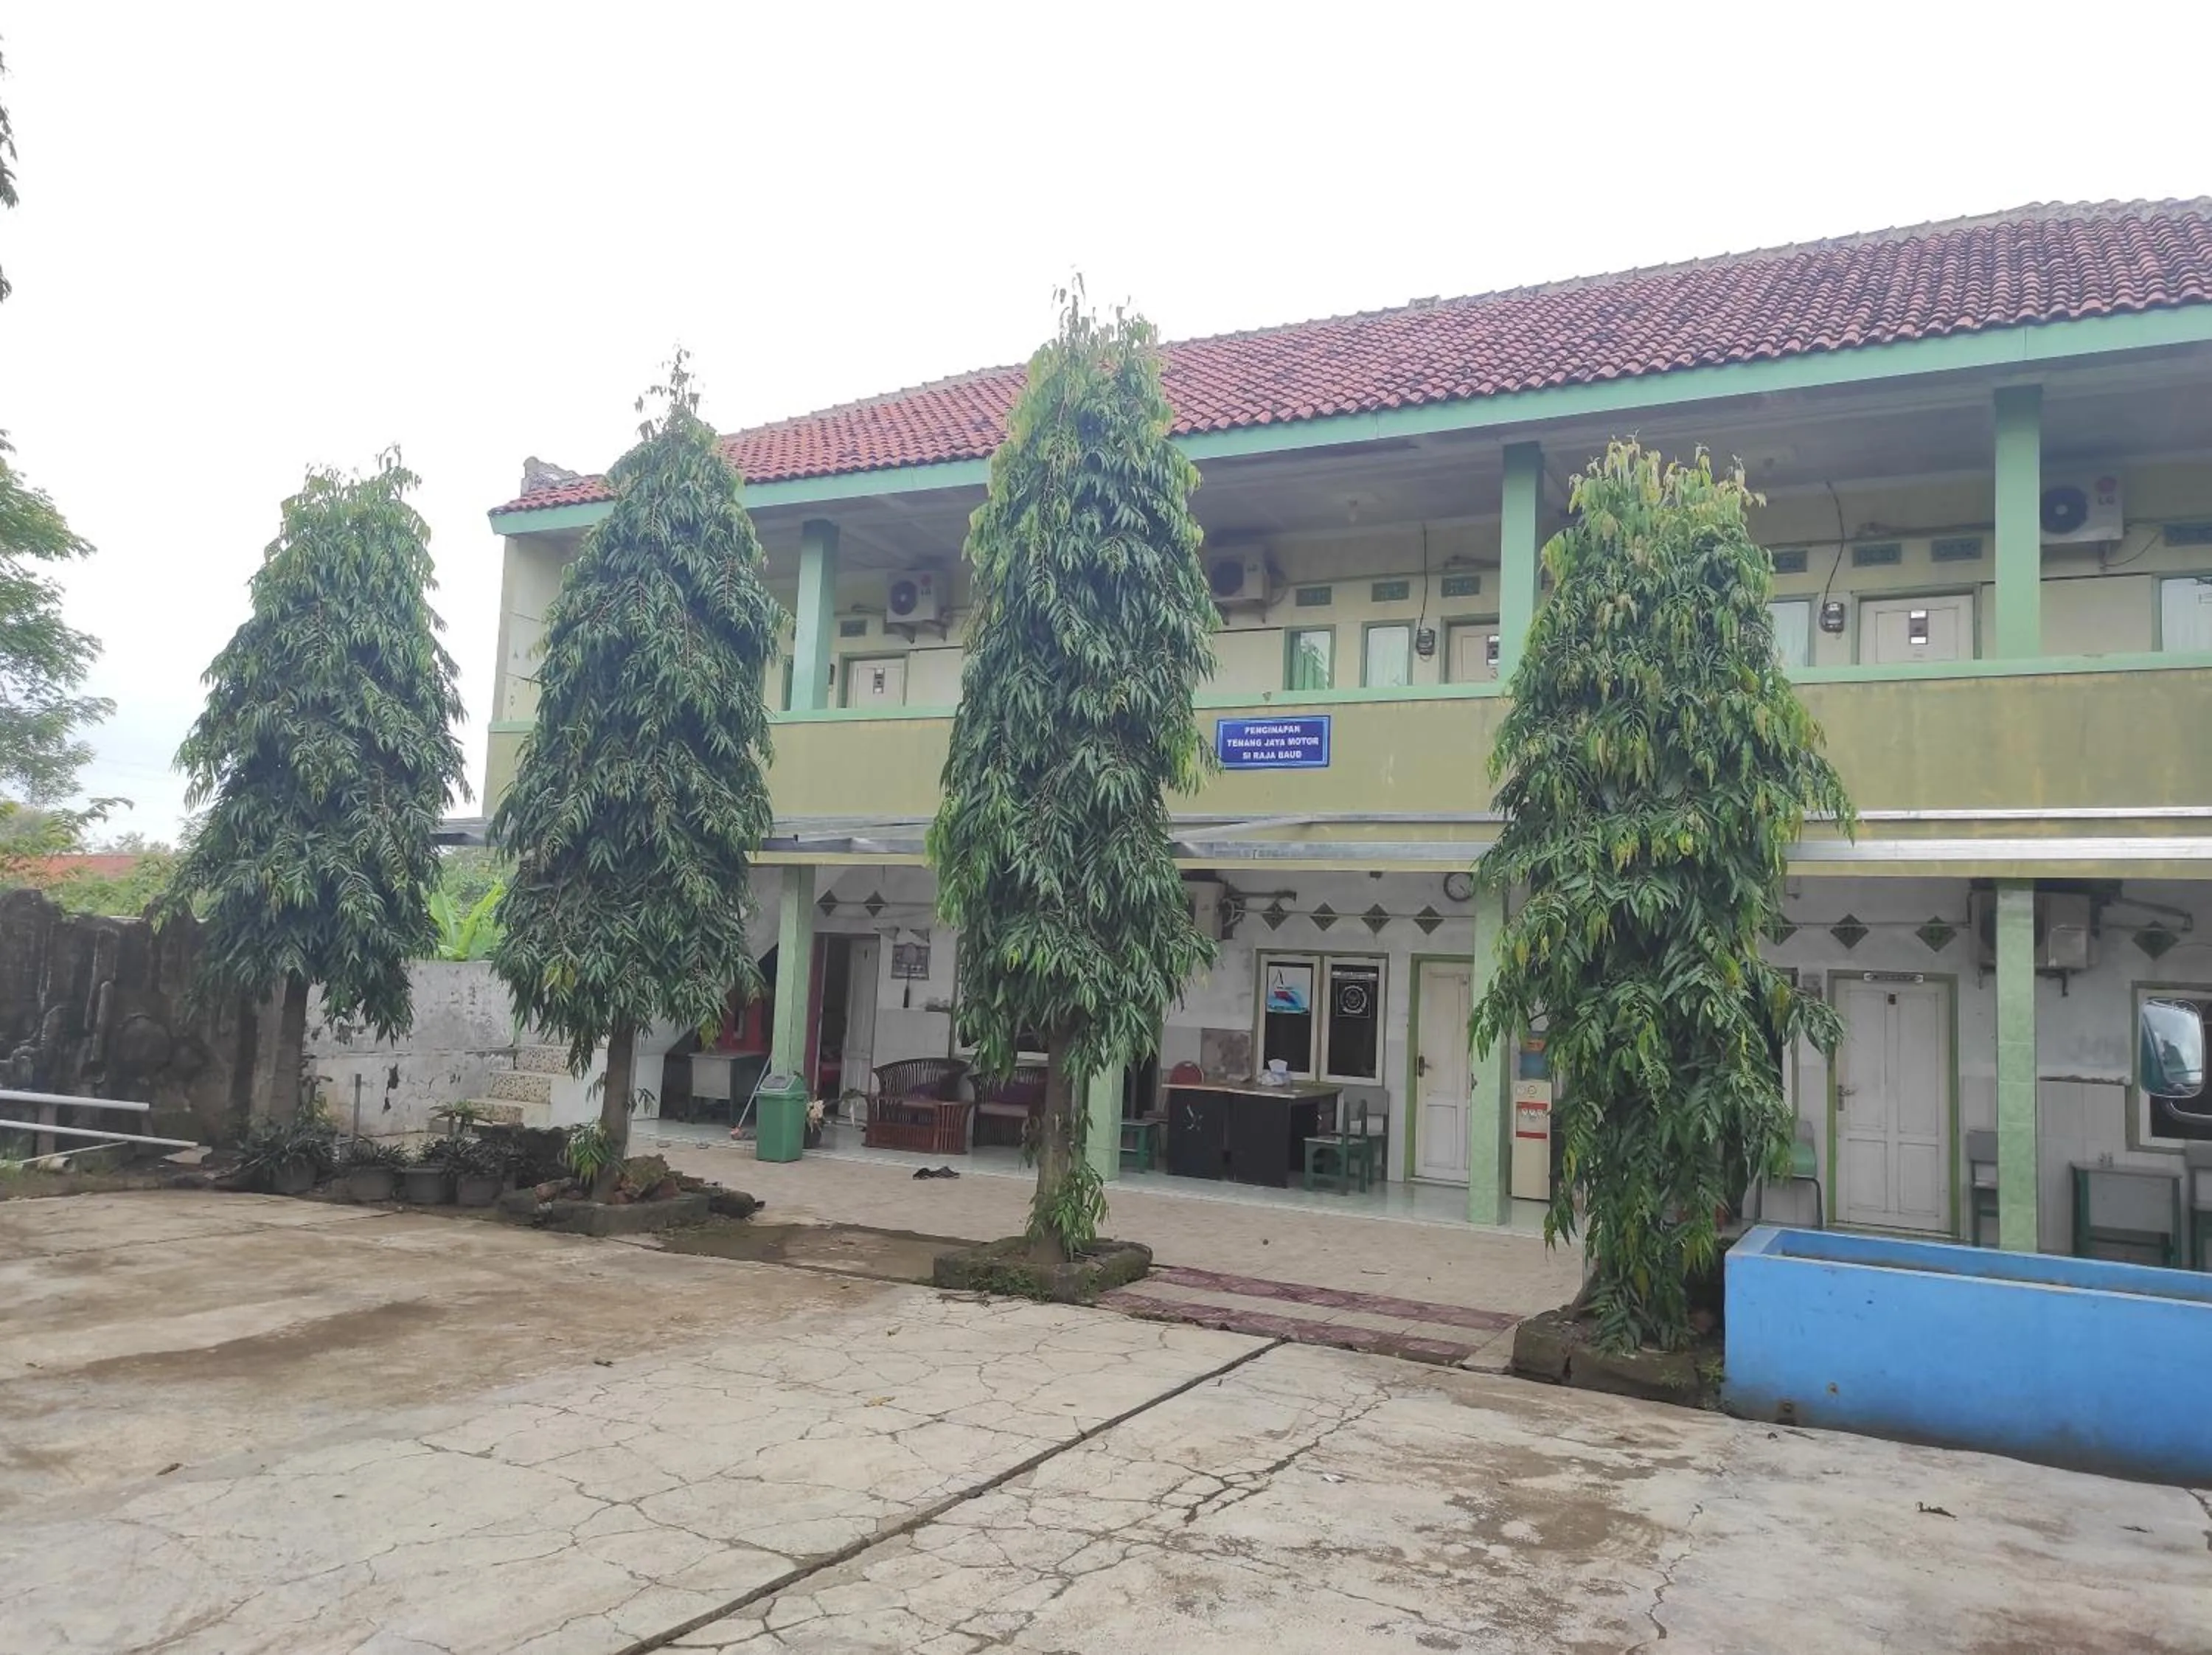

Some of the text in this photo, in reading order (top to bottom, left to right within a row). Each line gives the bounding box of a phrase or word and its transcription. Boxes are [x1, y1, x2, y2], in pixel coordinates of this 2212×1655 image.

[2098, 495, 2115, 505] LG
[1244, 725, 1301, 735] PENGINAPAN
[1227, 737, 1319, 747] TENANG JAYA MOTOR
[1242, 752, 1251, 760] SI
